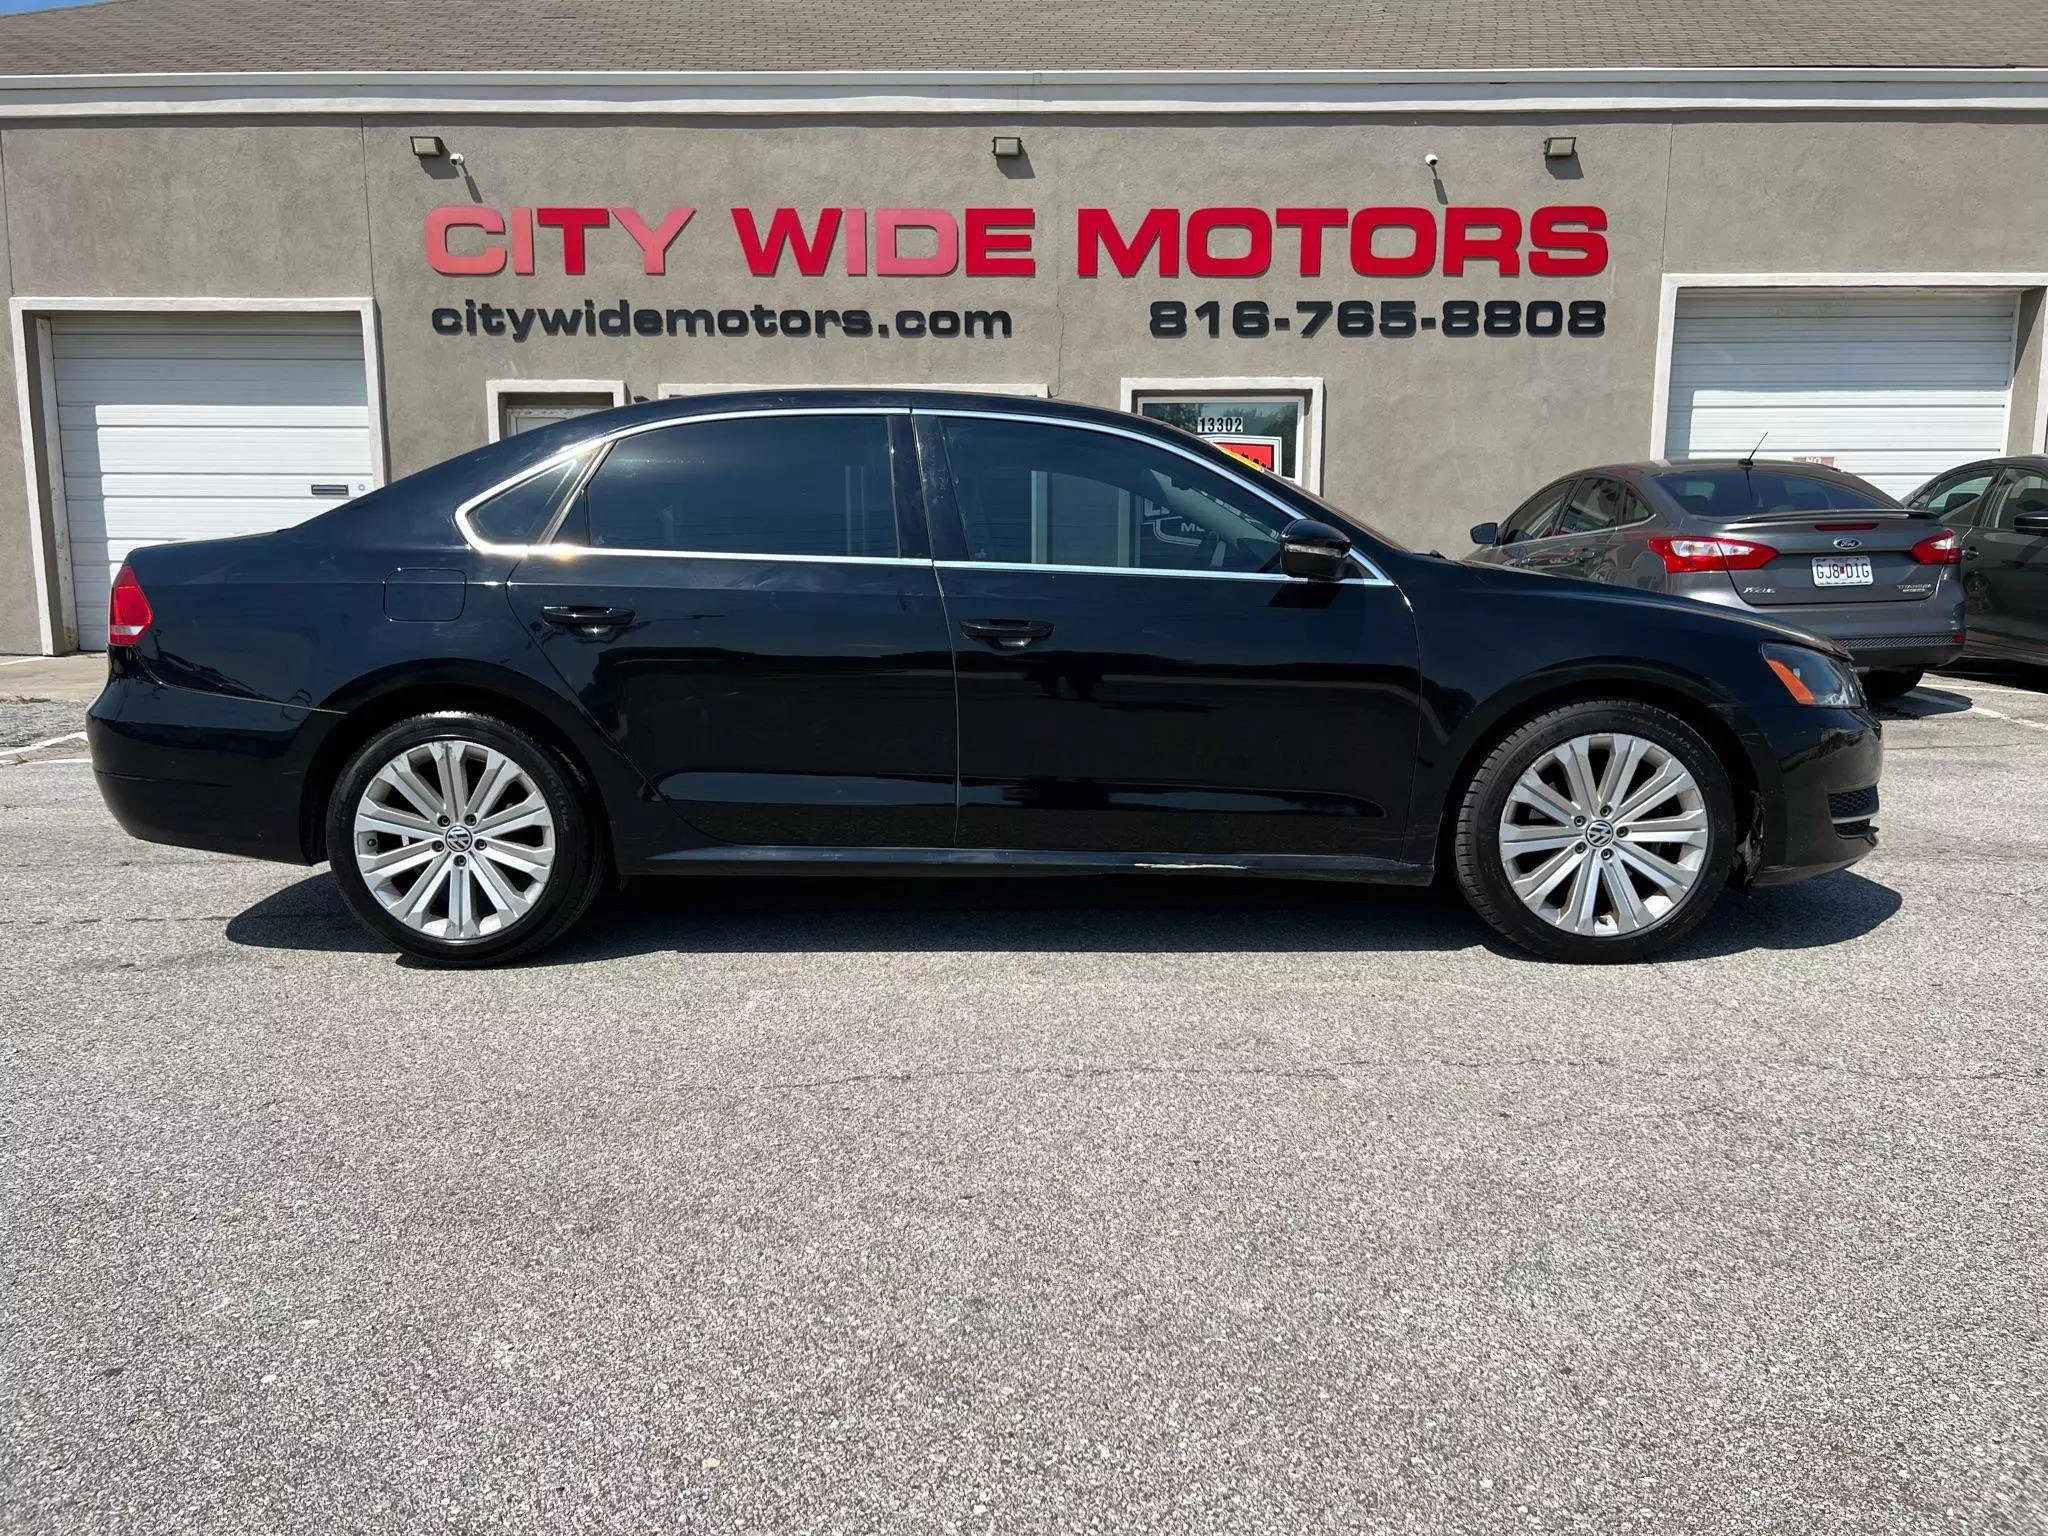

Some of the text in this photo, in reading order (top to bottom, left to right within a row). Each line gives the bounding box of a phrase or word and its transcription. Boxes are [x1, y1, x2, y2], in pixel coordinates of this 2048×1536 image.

[424, 204, 1608, 277] CITY WIDE MOTORS
[432, 299, 1012, 341] citywidemotors.com
[1150, 300, 1605, 337] 816-765-8808
[1199, 417, 1242, 432] 13302
